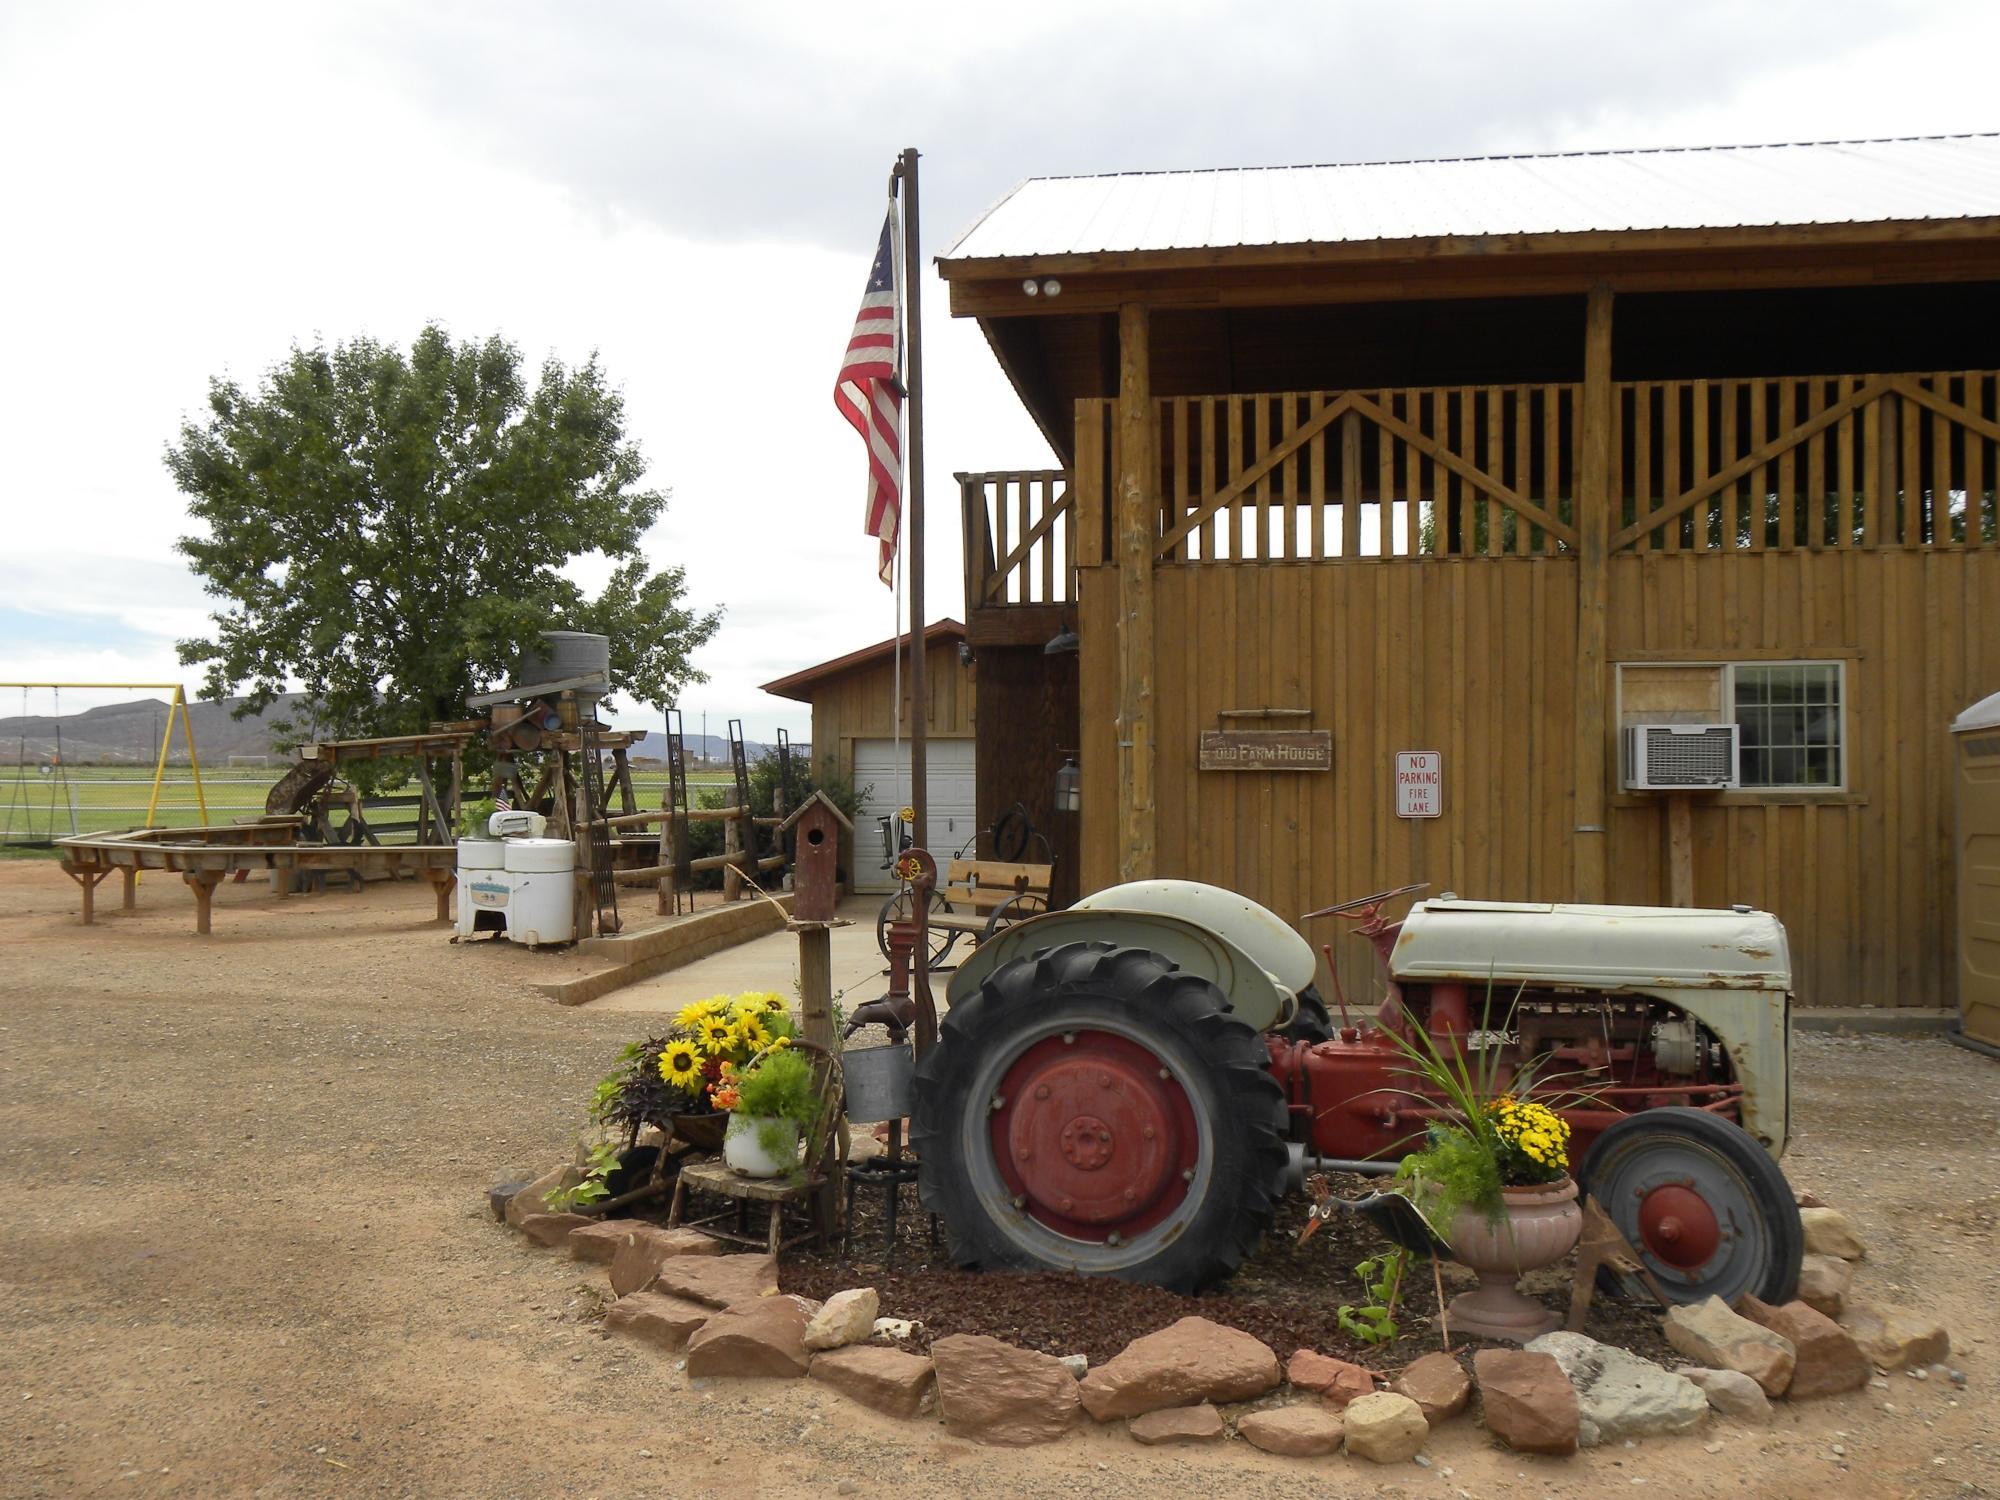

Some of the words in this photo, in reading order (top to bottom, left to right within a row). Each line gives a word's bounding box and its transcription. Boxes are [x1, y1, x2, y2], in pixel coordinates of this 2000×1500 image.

[1410, 757, 1426, 768] NO
[1399, 772, 1437, 784] PARKING
[1409, 788, 1429, 799] FIRE
[1408, 802, 1430, 813] LANE
